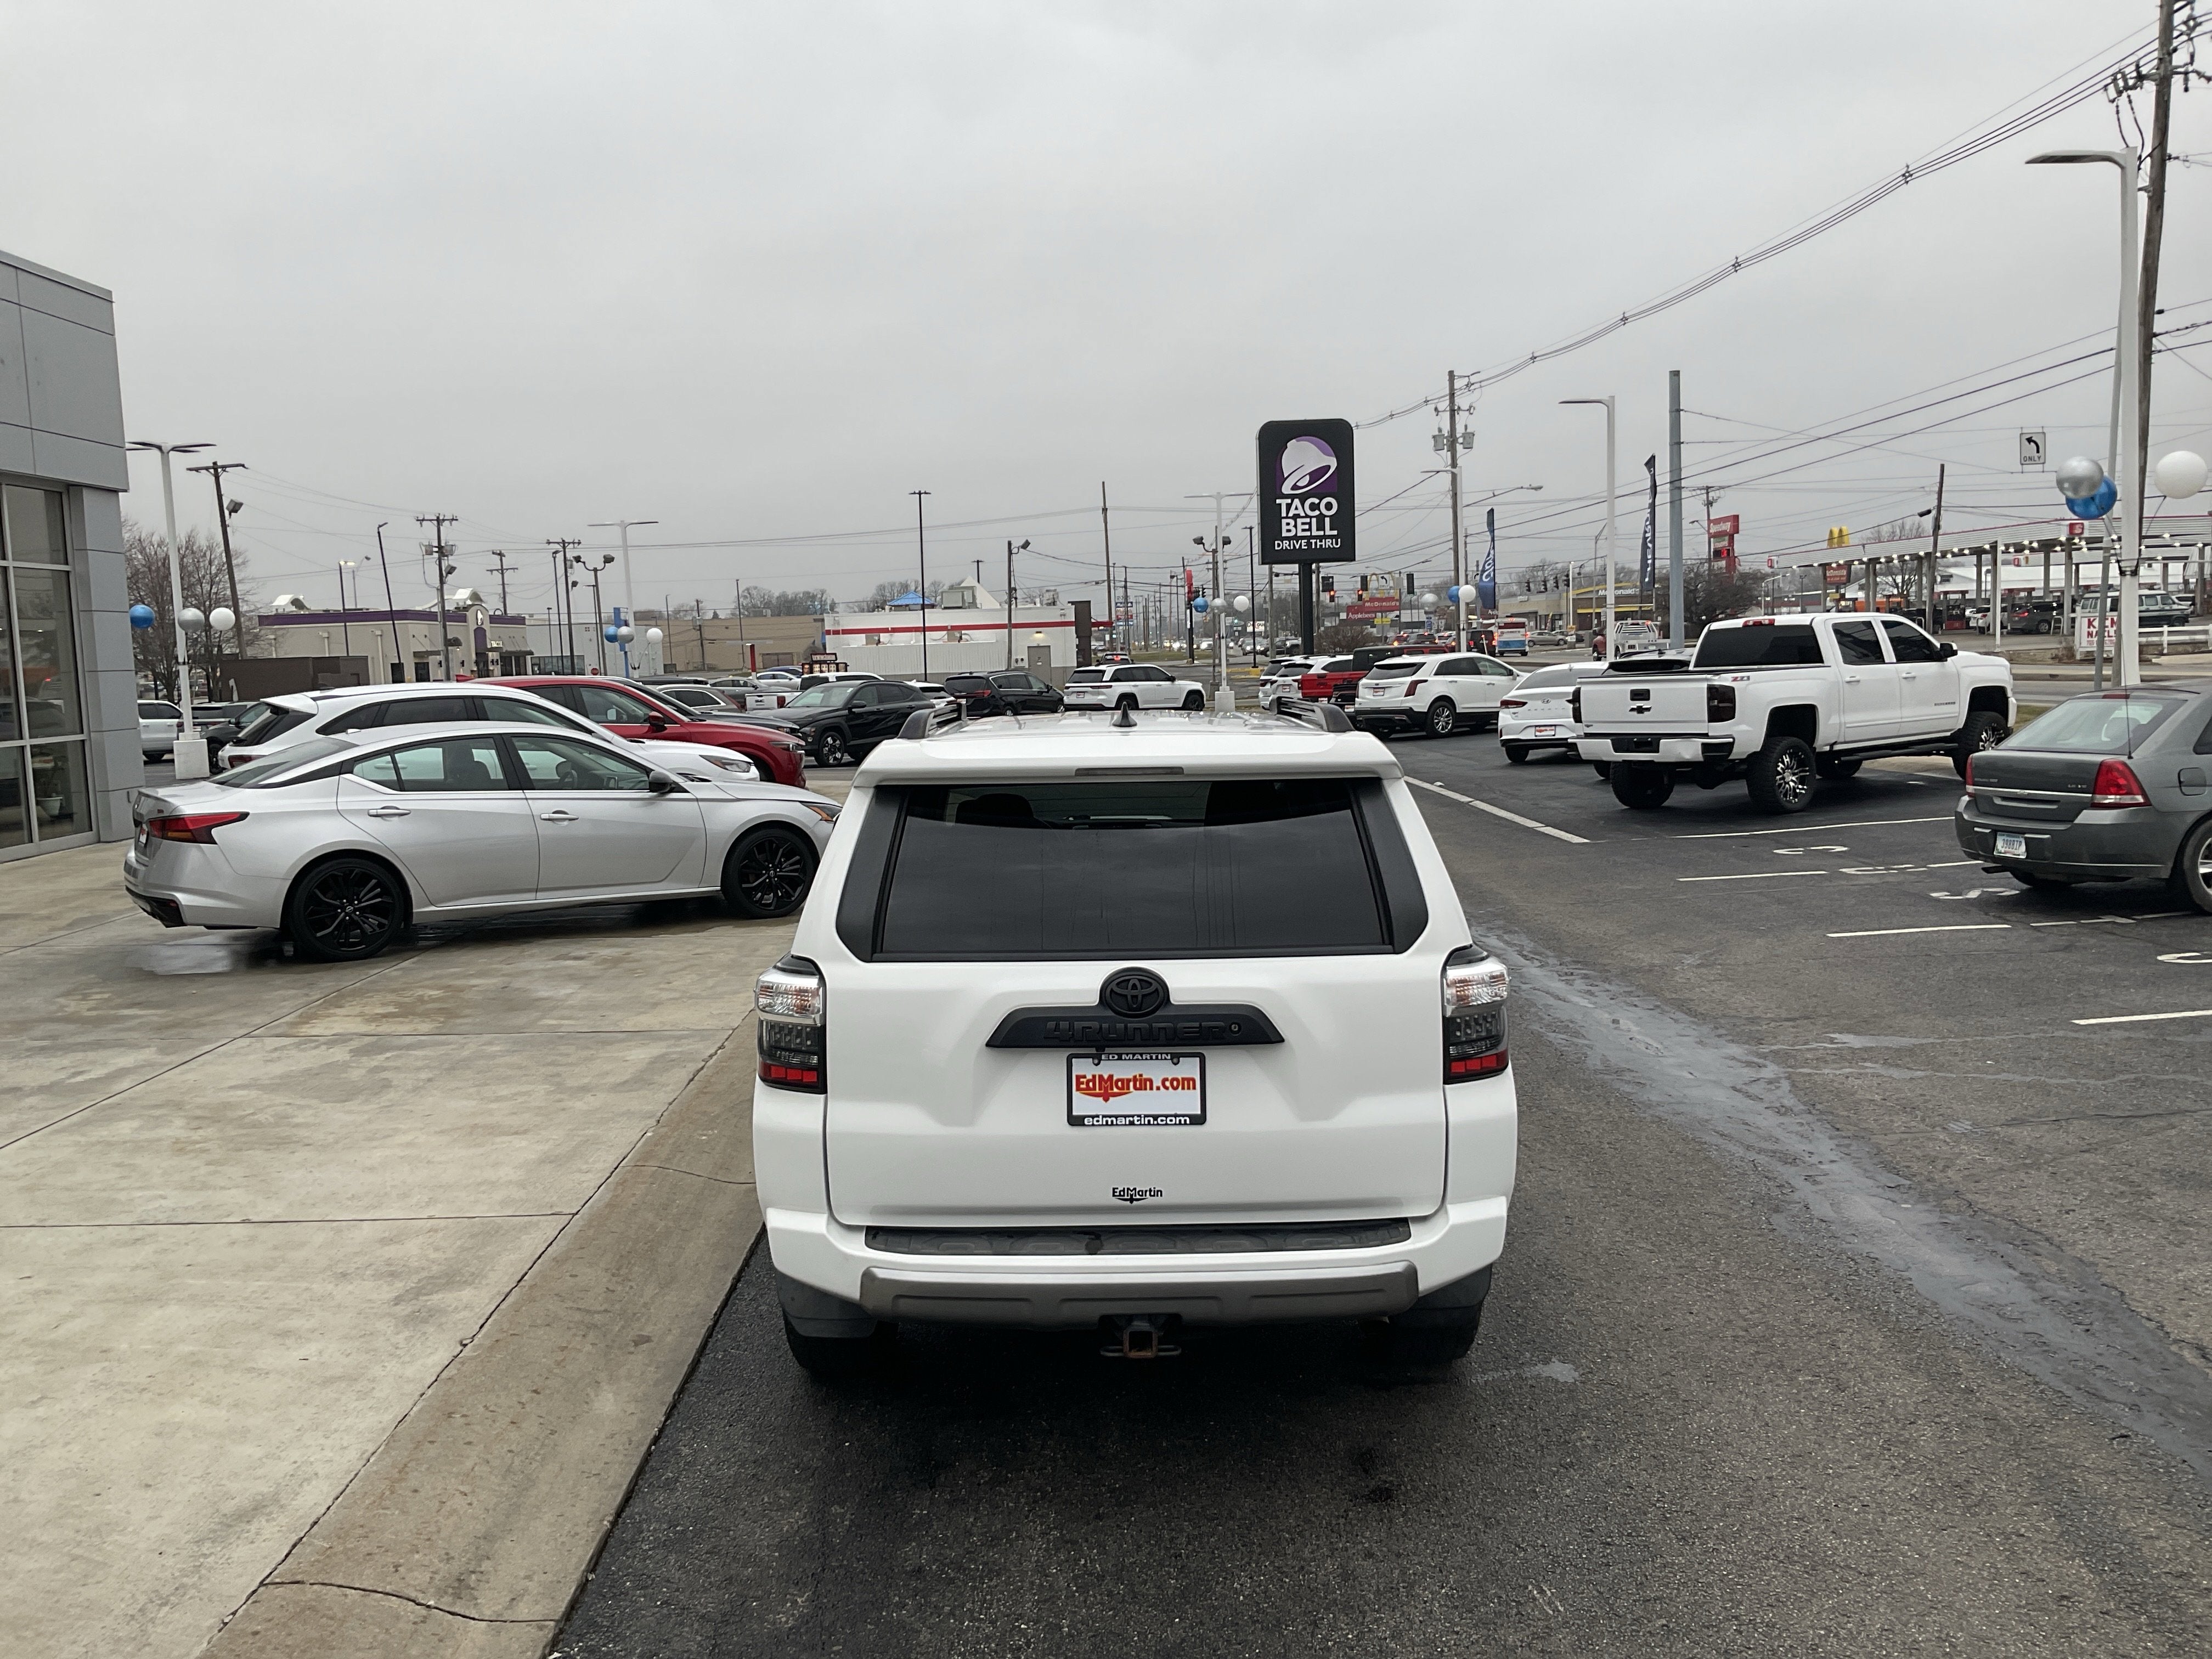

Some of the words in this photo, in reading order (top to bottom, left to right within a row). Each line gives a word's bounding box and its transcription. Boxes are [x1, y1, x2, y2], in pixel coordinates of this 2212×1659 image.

[1276, 497, 1338, 517] TACO
[1282, 517, 1338, 537] BELL
[1274, 540, 1307, 550] DRIVE
[1310, 538, 1341, 549] THRU
[1084, 1115, 1190, 1125] edmartin.com
